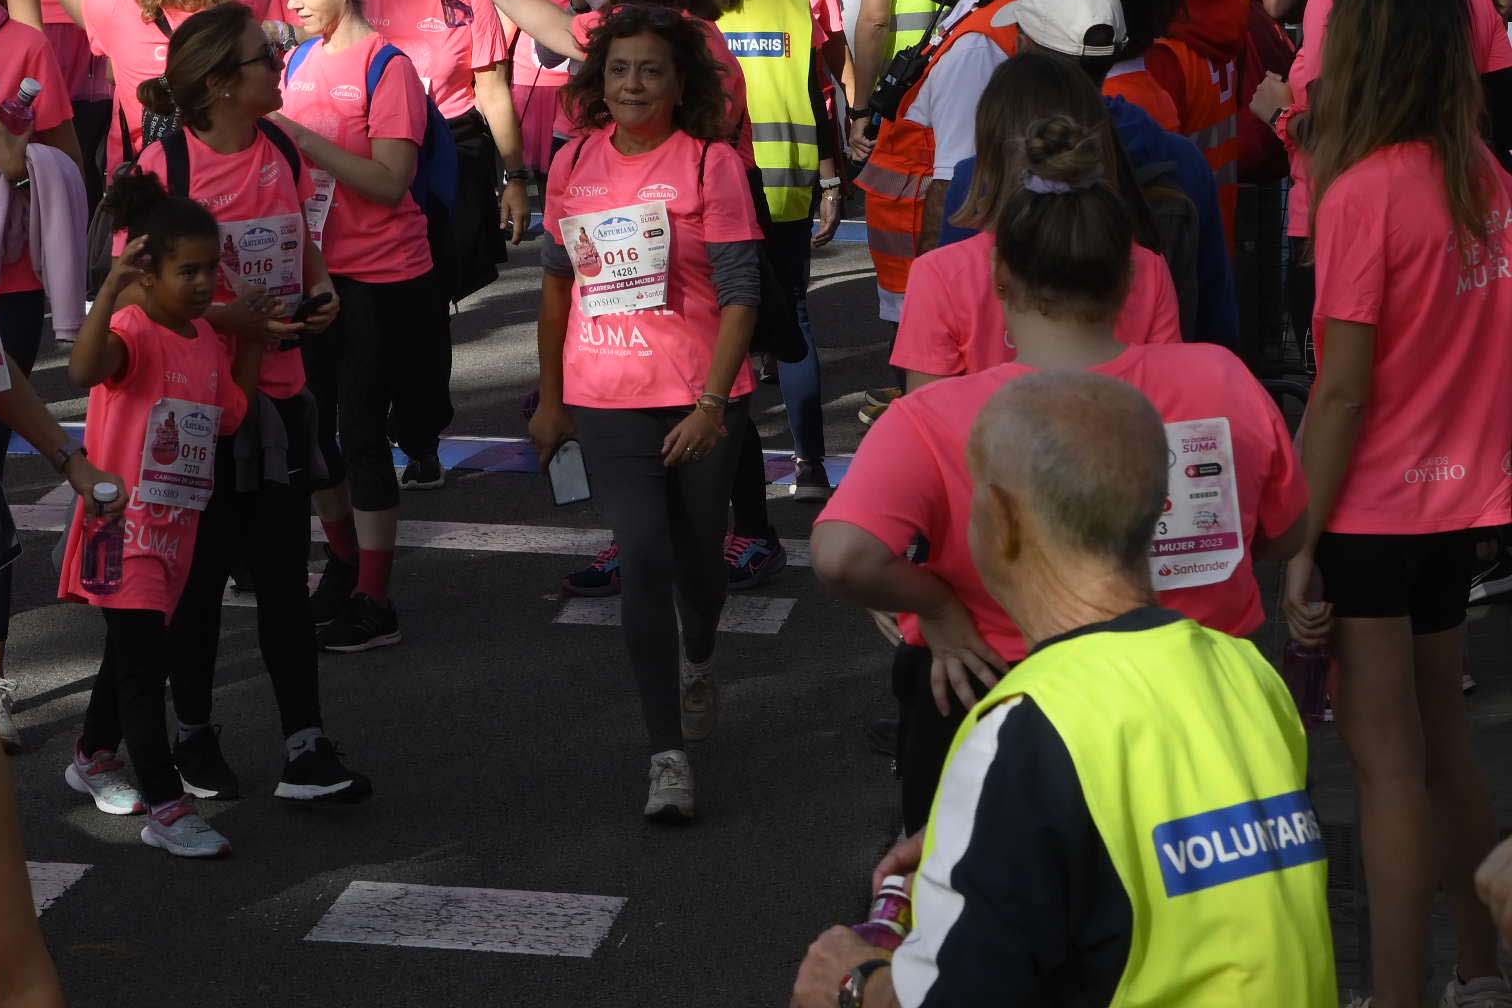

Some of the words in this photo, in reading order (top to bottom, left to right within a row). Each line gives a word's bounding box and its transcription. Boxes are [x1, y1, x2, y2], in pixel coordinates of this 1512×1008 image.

[569, 185, 608, 197] OYSHO
[641, 216, 660, 224] SUMA
[597, 227, 635, 238] ASTURIANA
[604, 247, 639, 264] 016
[243, 259, 273, 274] 016
[611, 267, 638, 278] 14281
[589, 283, 615, 293] CARRERA
[616, 281, 624, 289] DE
[625, 279, 633, 287] LA
[634, 277, 655, 285] MUJER
[589, 296, 620, 308] OYSHO
[579, 321, 649, 347] SUMA
[181, 444, 207, 461] 016
[1183, 442, 1217, 453] SUMA
[1405, 465, 1465, 484] OYSHO
[1159, 541, 1195, 552] MUJER
[1200, 537, 1224, 548] 2023
[1173, 561, 1230, 576] Santander
